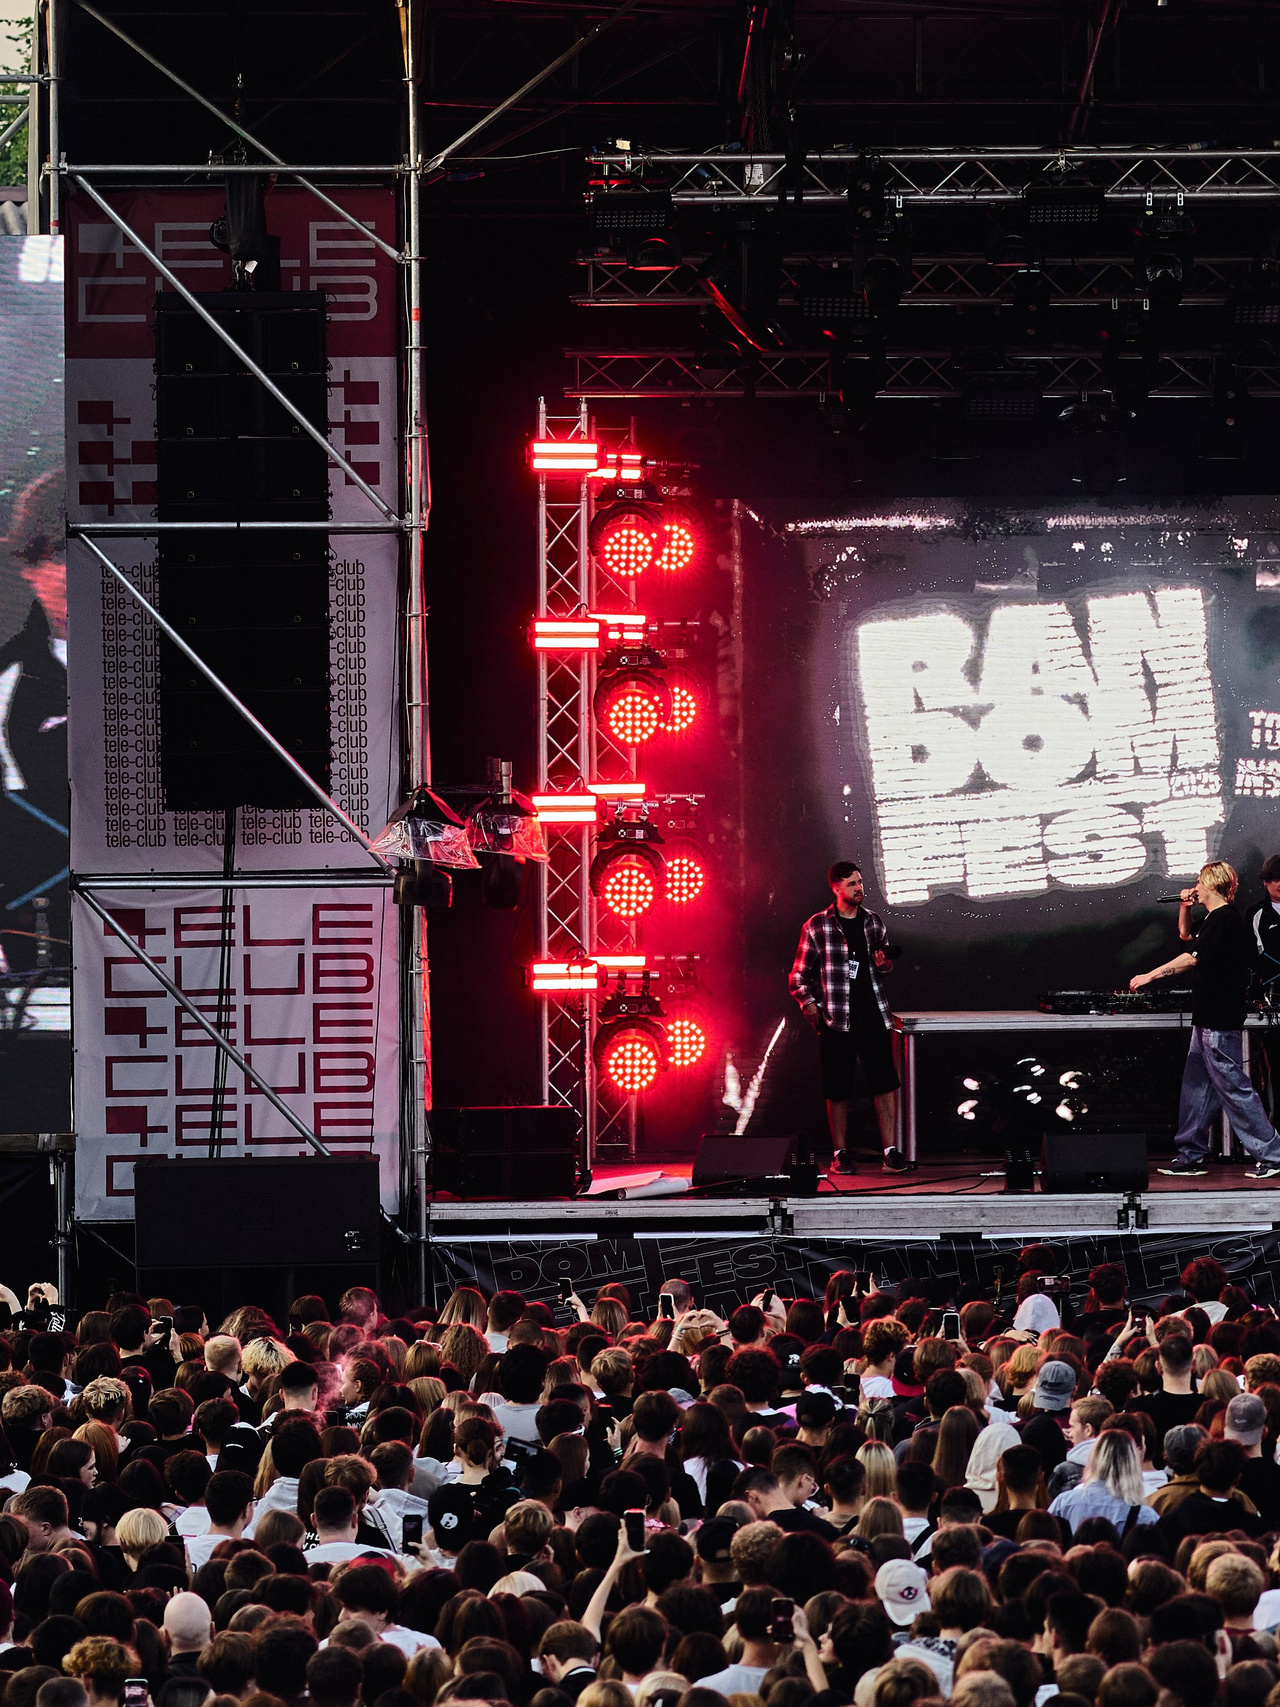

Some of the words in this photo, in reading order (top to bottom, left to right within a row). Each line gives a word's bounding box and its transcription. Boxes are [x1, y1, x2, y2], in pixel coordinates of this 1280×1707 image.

[78, 221, 377, 269] TEE
[100, 562, 159, 578] tee-club
[101, 577, 159, 594] teleclub
[101, 609, 160, 625] tele-clu
[105, 816, 166, 832] tele-club
[173, 815, 224, 830] tele-clu
[241, 813, 302, 829] tele-club
[309, 812, 369, 828] tele-ub
[106, 832, 166, 847] tele-club
[174, 831, 225, 846] tele-clu
[241, 829, 302, 846] tele-club
[309, 828, 369, 844] tele-cl
[876, 796, 1226, 905] FEST
[104, 952, 374, 998] CLUB
[106, 1051, 374, 1098] CLUB
[488, 1239, 646, 1293] DOM
[658, 1238, 810, 1288] FEST
